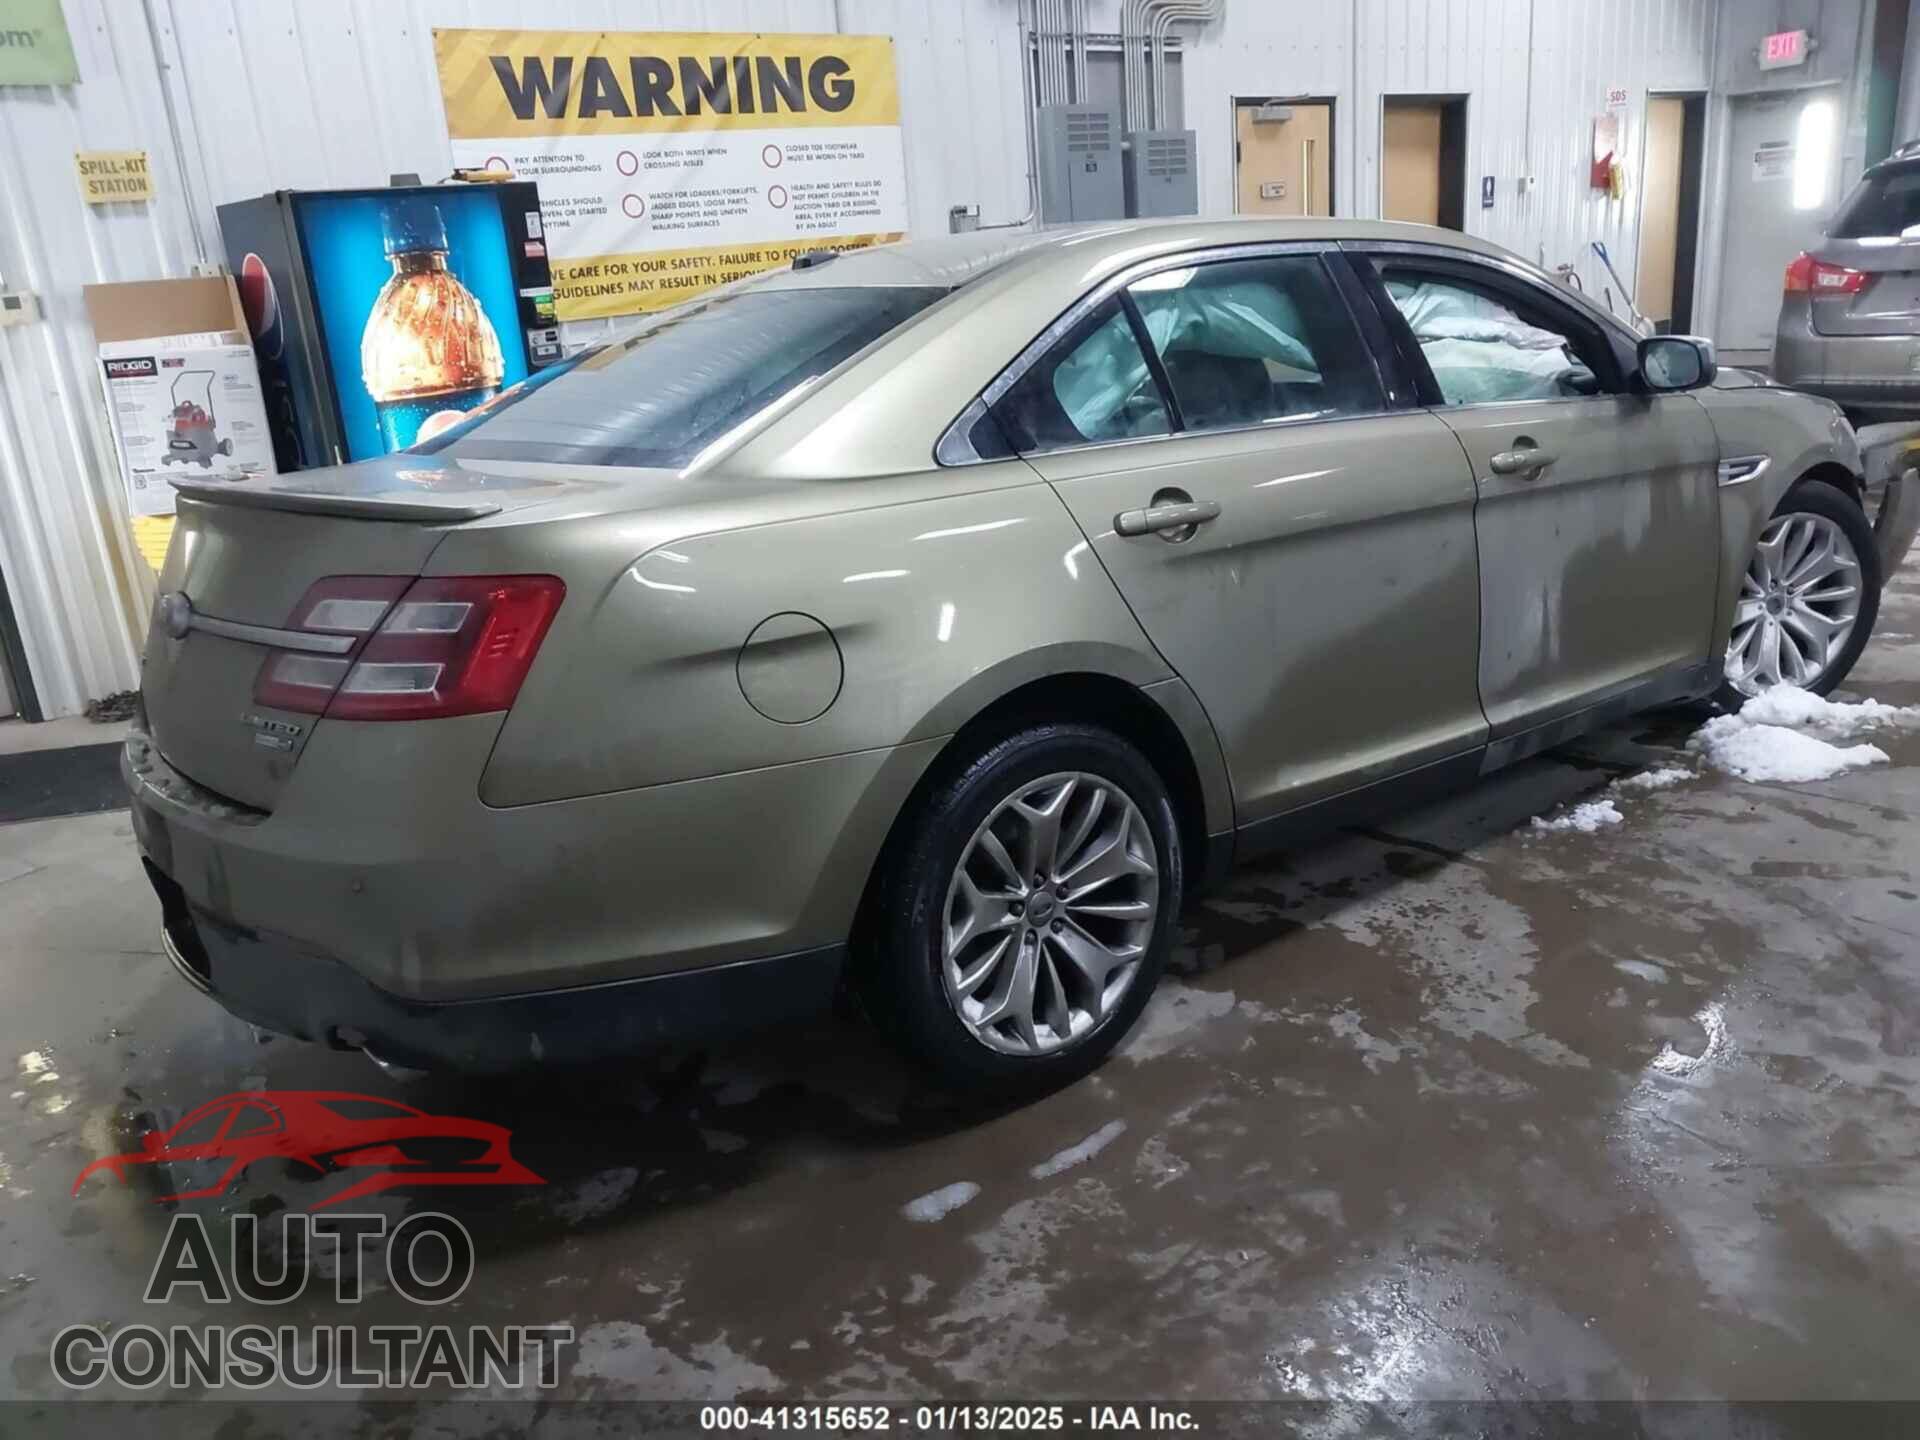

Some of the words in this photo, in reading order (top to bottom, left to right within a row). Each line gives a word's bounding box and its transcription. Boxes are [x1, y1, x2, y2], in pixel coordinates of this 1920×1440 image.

[489, 55, 855, 120] WARNING
[533, 155, 573, 163] ATTENTION
[575, 154, 585, 162] TO
[643, 151, 662, 159] LOOK
[79, 159, 146, 175] SPILL-KIT
[541, 165, 602, 174] SURROUNDINGS
[644, 160, 681, 169] CROSSING
[88, 178, 148, 194] STATION
[675, 190, 688, 199] FOR
[569, 265, 600, 280] CARE
[604, 263, 629, 276] FOR
[632, 260, 667, 274] YOUR
[671, 256, 716, 271] SAFETY.
[719, 250, 762, 266] FAILURE
[765, 250, 780, 262] TO
[553, 282, 624, 300] GUIDELINES
[628, 278, 655, 293] MAY
[659, 274, 700, 290] RESULT
[704, 273, 717, 285] IN
